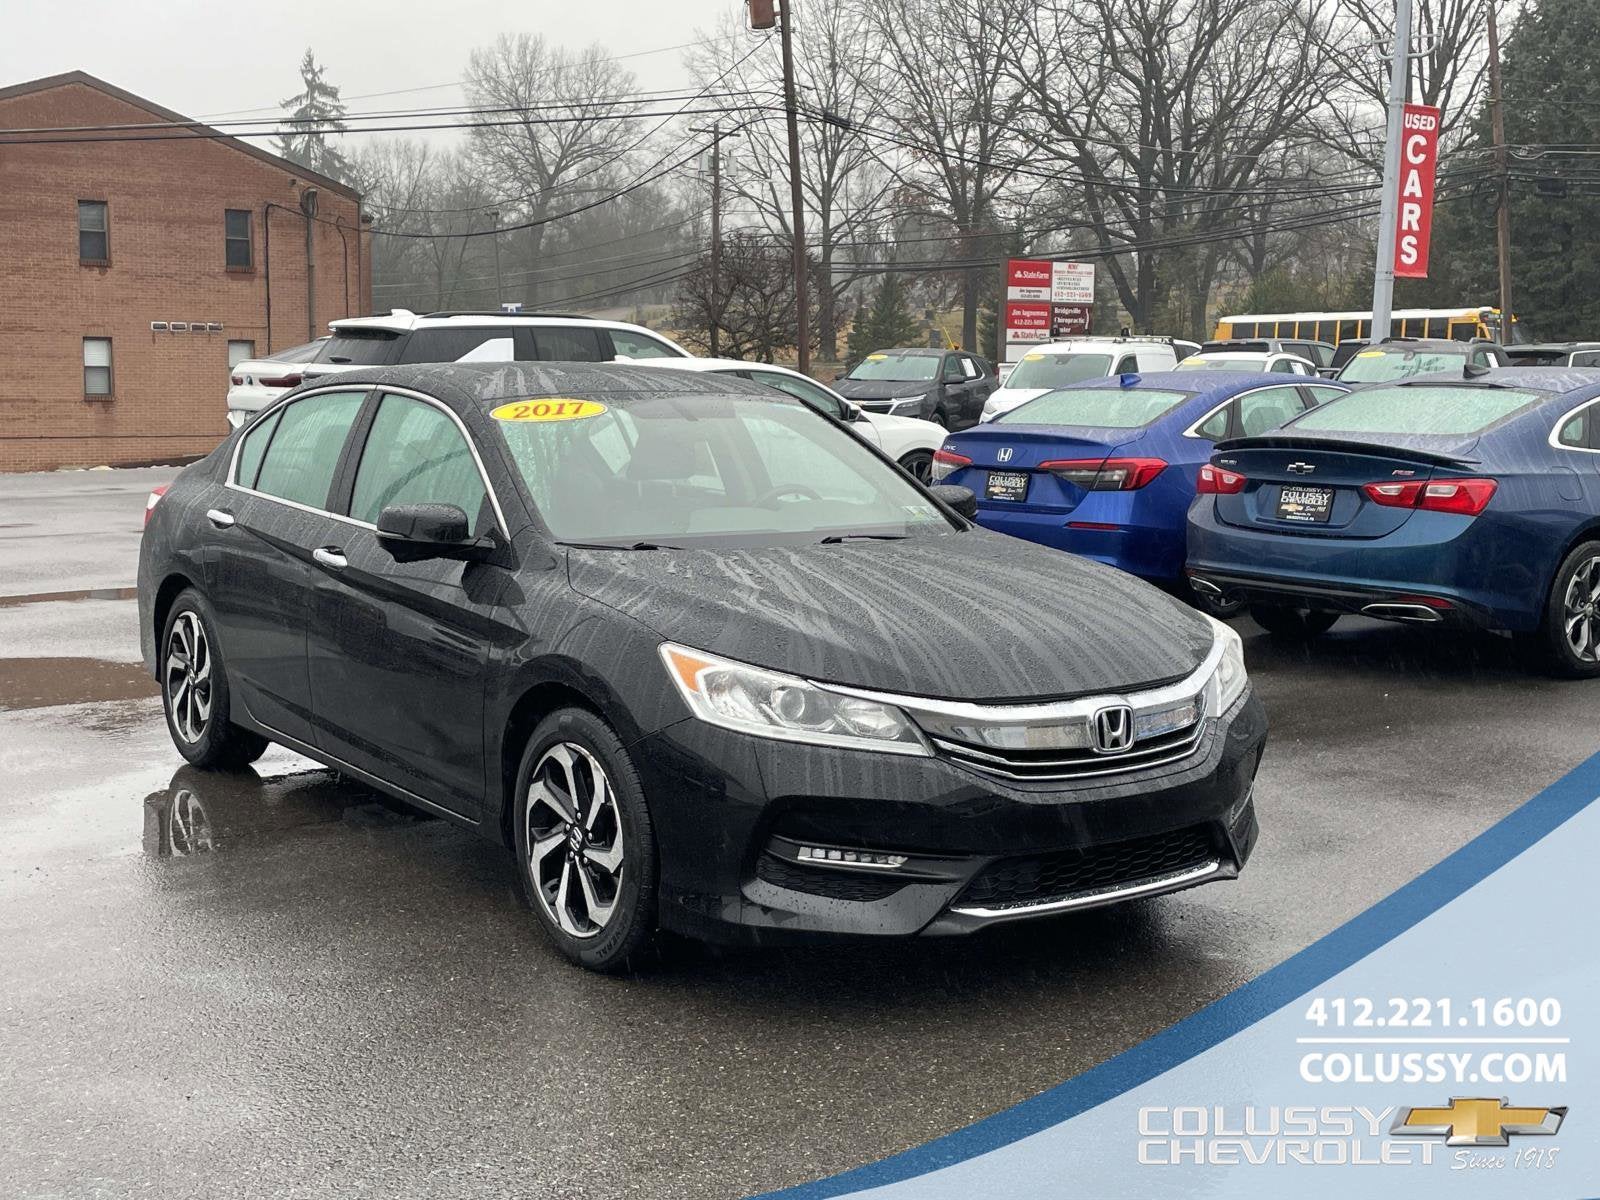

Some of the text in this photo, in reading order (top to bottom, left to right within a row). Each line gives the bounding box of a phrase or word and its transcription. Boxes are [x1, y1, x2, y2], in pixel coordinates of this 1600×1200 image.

[1404, 113, 1436, 131] USED
[1401, 134, 1427, 265] CARS
[1054, 307, 1082, 315] Bridgeville
[1054, 317, 1085, 325] Chiropractic
[513, 402, 584, 419] 2017
[1281, 490, 1331, 502] COLUSSY
